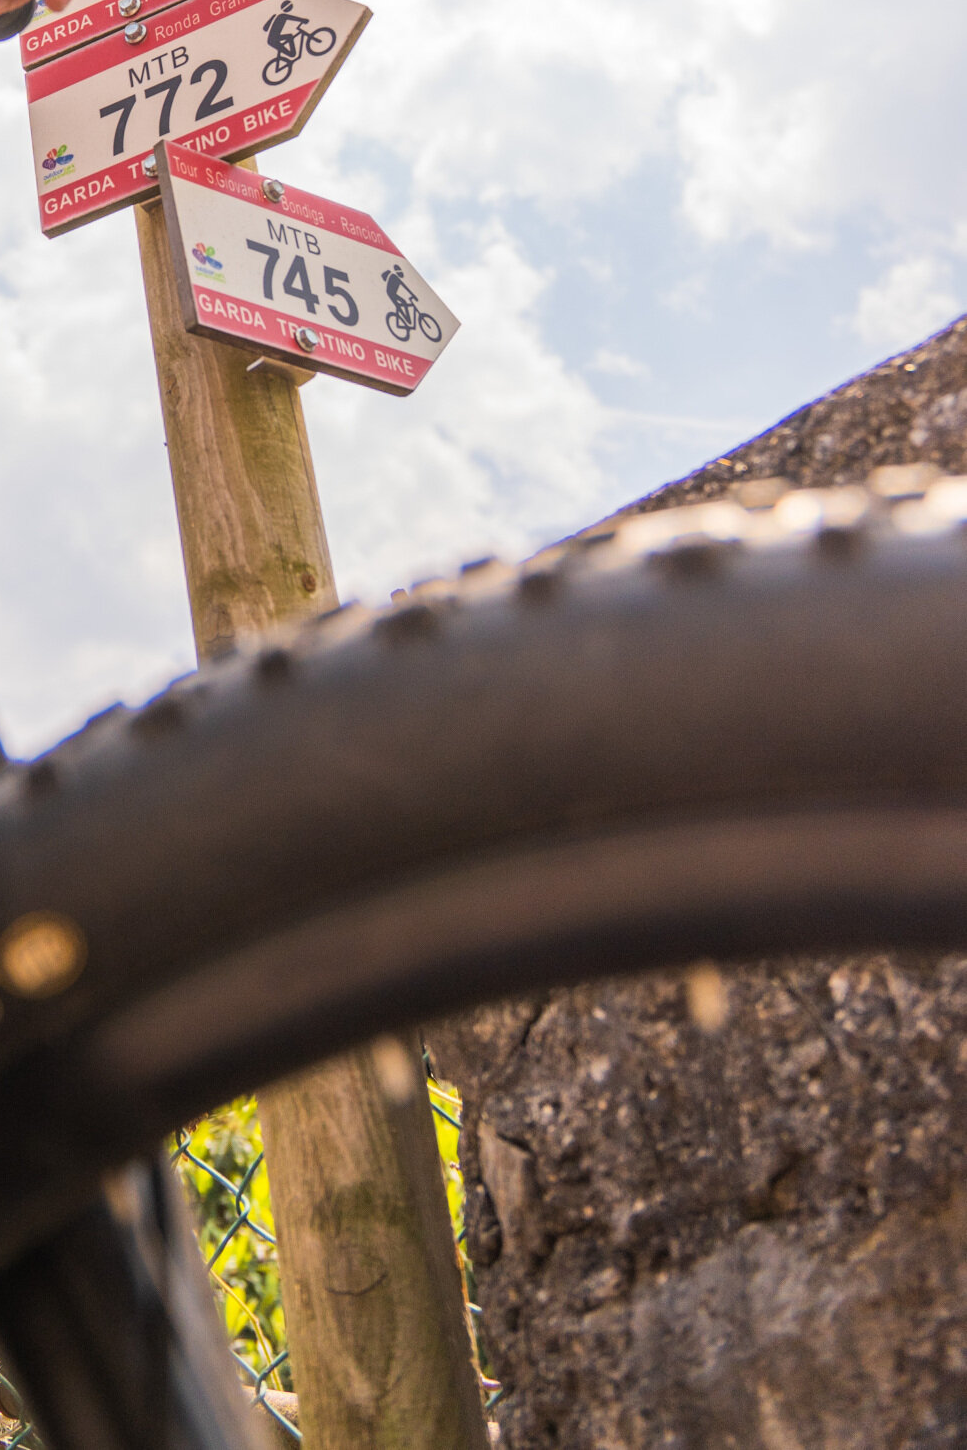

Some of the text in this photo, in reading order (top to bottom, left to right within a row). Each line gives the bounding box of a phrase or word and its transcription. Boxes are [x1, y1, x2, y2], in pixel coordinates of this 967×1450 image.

[26, 13, 94, 52] GARDA
[128, 46, 190, 88] MTB
[154, 11, 201, 42] Ronda
[99, 59, 235, 158] 772
[44, 100, 293, 215] GARDA TTINO BIKE
[172, 156, 198, 179] Tour
[280, 194, 325, 226] Bondiga
[340, 216, 384, 246] Rancion
[266, 218, 322, 257] MTB
[246, 238, 360, 328] 745
[198, 293, 417, 378] GARDA TRNTINO BIKE
